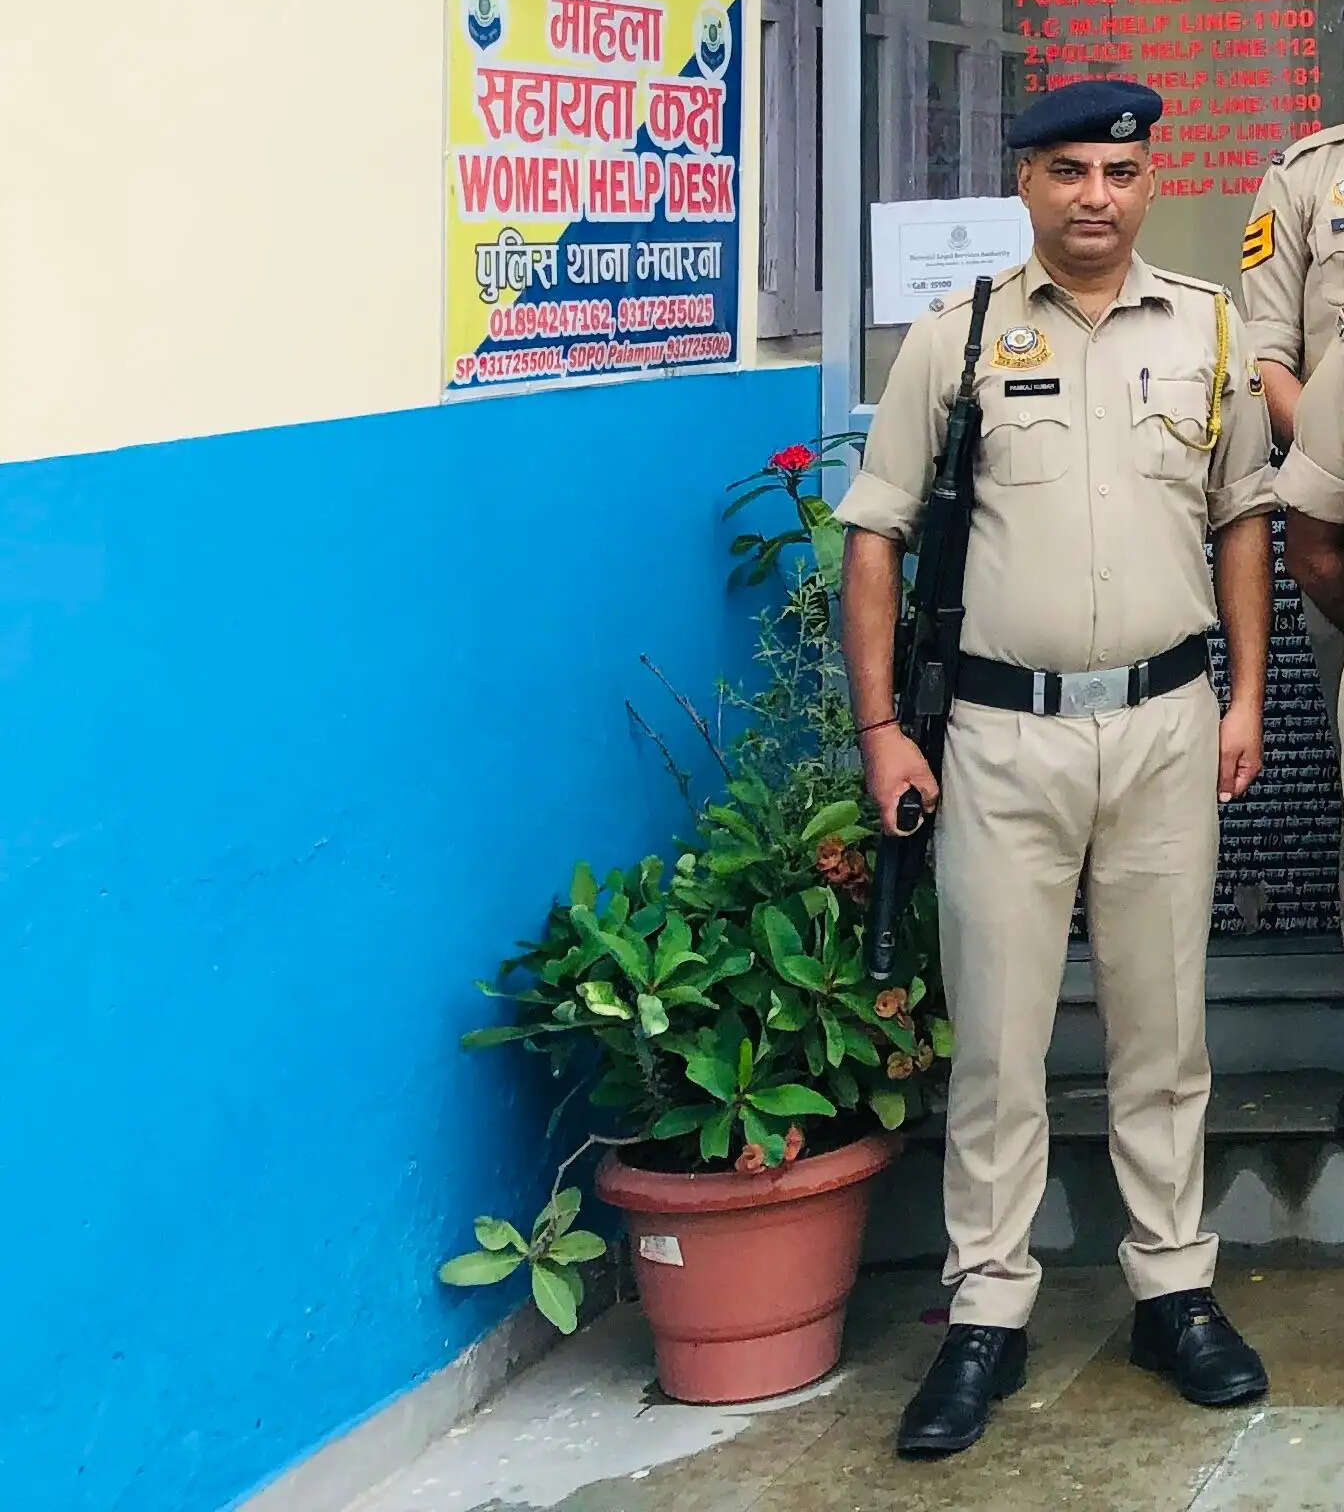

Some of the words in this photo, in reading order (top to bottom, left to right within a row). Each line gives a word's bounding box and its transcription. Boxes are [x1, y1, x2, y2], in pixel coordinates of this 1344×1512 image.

[1141, 39, 1200, 61] HELP
[1147, 71, 1208, 89] HELP
[477, 67, 637, 143] सहायता
[649, 82, 723, 153] कक्ष
[459, 154, 580, 214] WOMEN
[589, 159, 661, 214] HELP
[668, 161, 733, 214] DESK
[1160, 176, 1214, 196] HELP
[1221, 174, 1264, 196] LIN
[475, 226, 560, 304] पुलिस
[567, 243, 632, 285] थाना
[636, 241, 723, 282] भवारना
[618, 297, 714, 329] 9317255025
[455, 360, 474, 380] SP
[568, 345, 604, 370] SDPO
